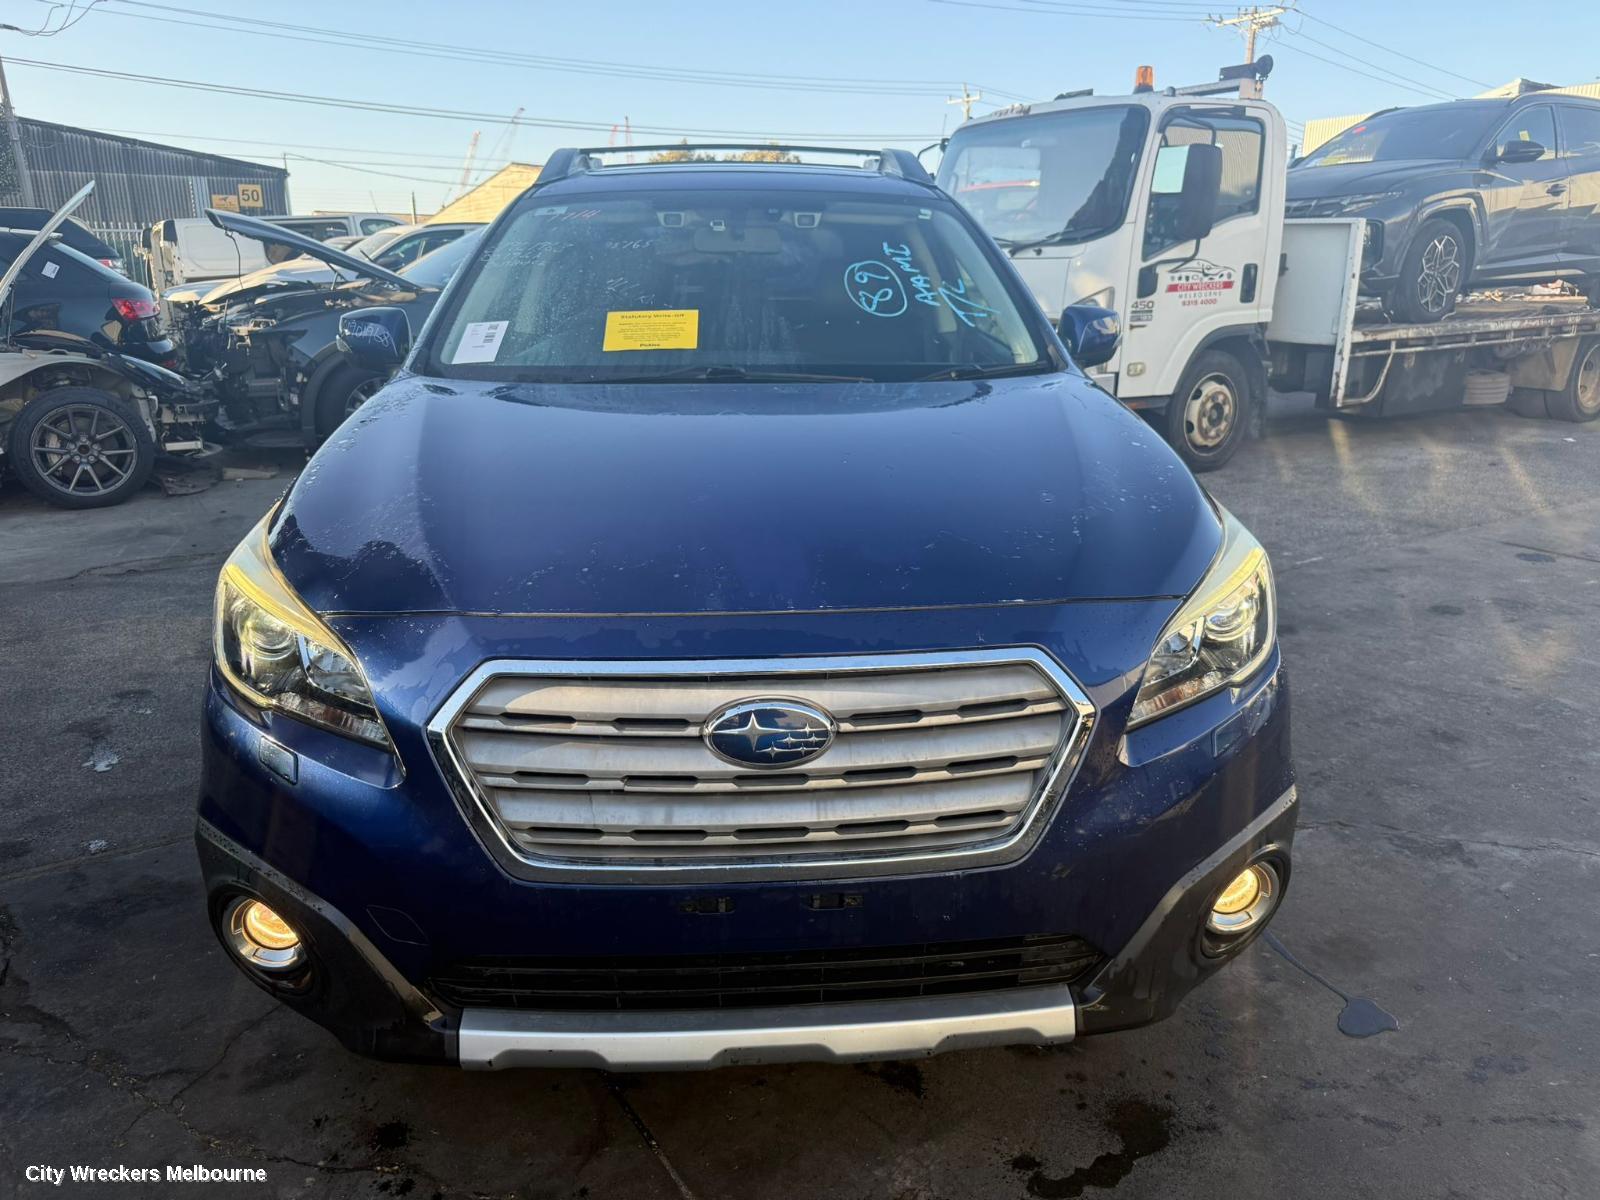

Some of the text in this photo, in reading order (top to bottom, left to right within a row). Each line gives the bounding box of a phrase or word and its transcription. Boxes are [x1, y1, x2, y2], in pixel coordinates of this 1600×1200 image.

[242, 189, 260, 202] 50
[1177, 281, 1223, 291] CITY WRECKERS
[1179, 291, 1222, 299] MELBOURNE
[1131, 301, 1154, 309] 450
